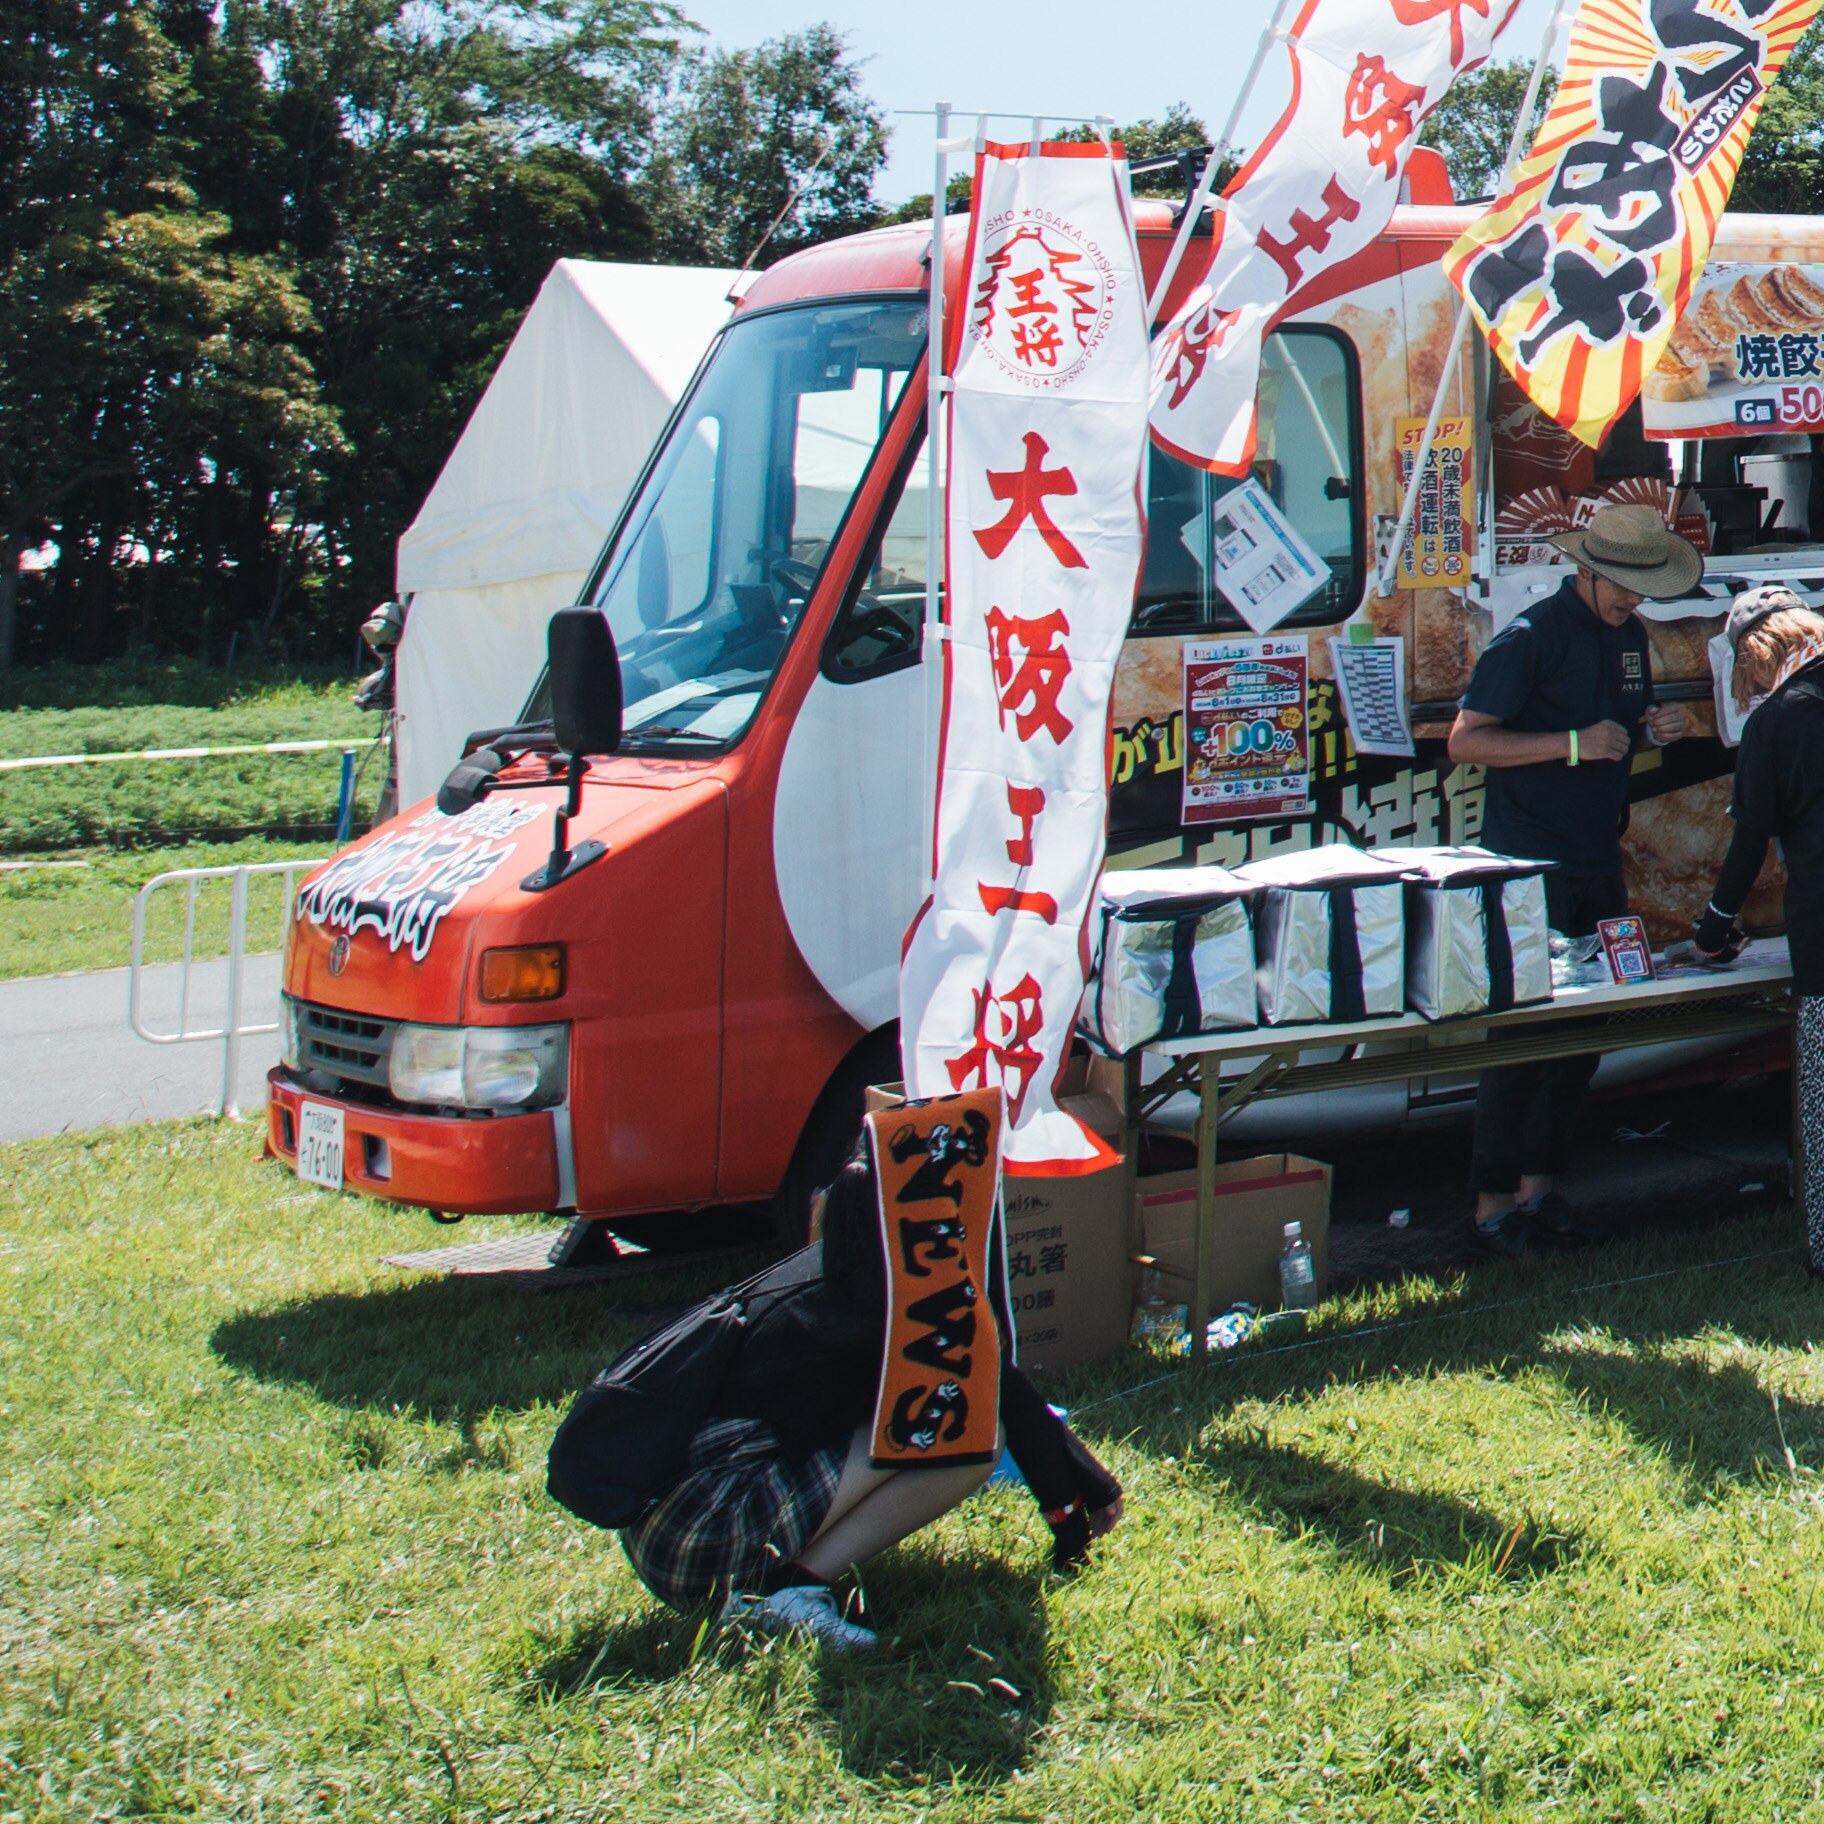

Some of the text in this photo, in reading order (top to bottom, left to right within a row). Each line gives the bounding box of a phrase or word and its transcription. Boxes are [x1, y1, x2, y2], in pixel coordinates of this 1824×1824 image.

[1681, 77, 1753, 164] こだわり
[1005, 267, 1064, 367] 王将
[1740, 405, 1772, 422] 6個
[945, 430, 1090, 1134] 大阪王将
[1201, 720, 1296, 756] +100%
[890, 1110, 990, 1453] NEWS
